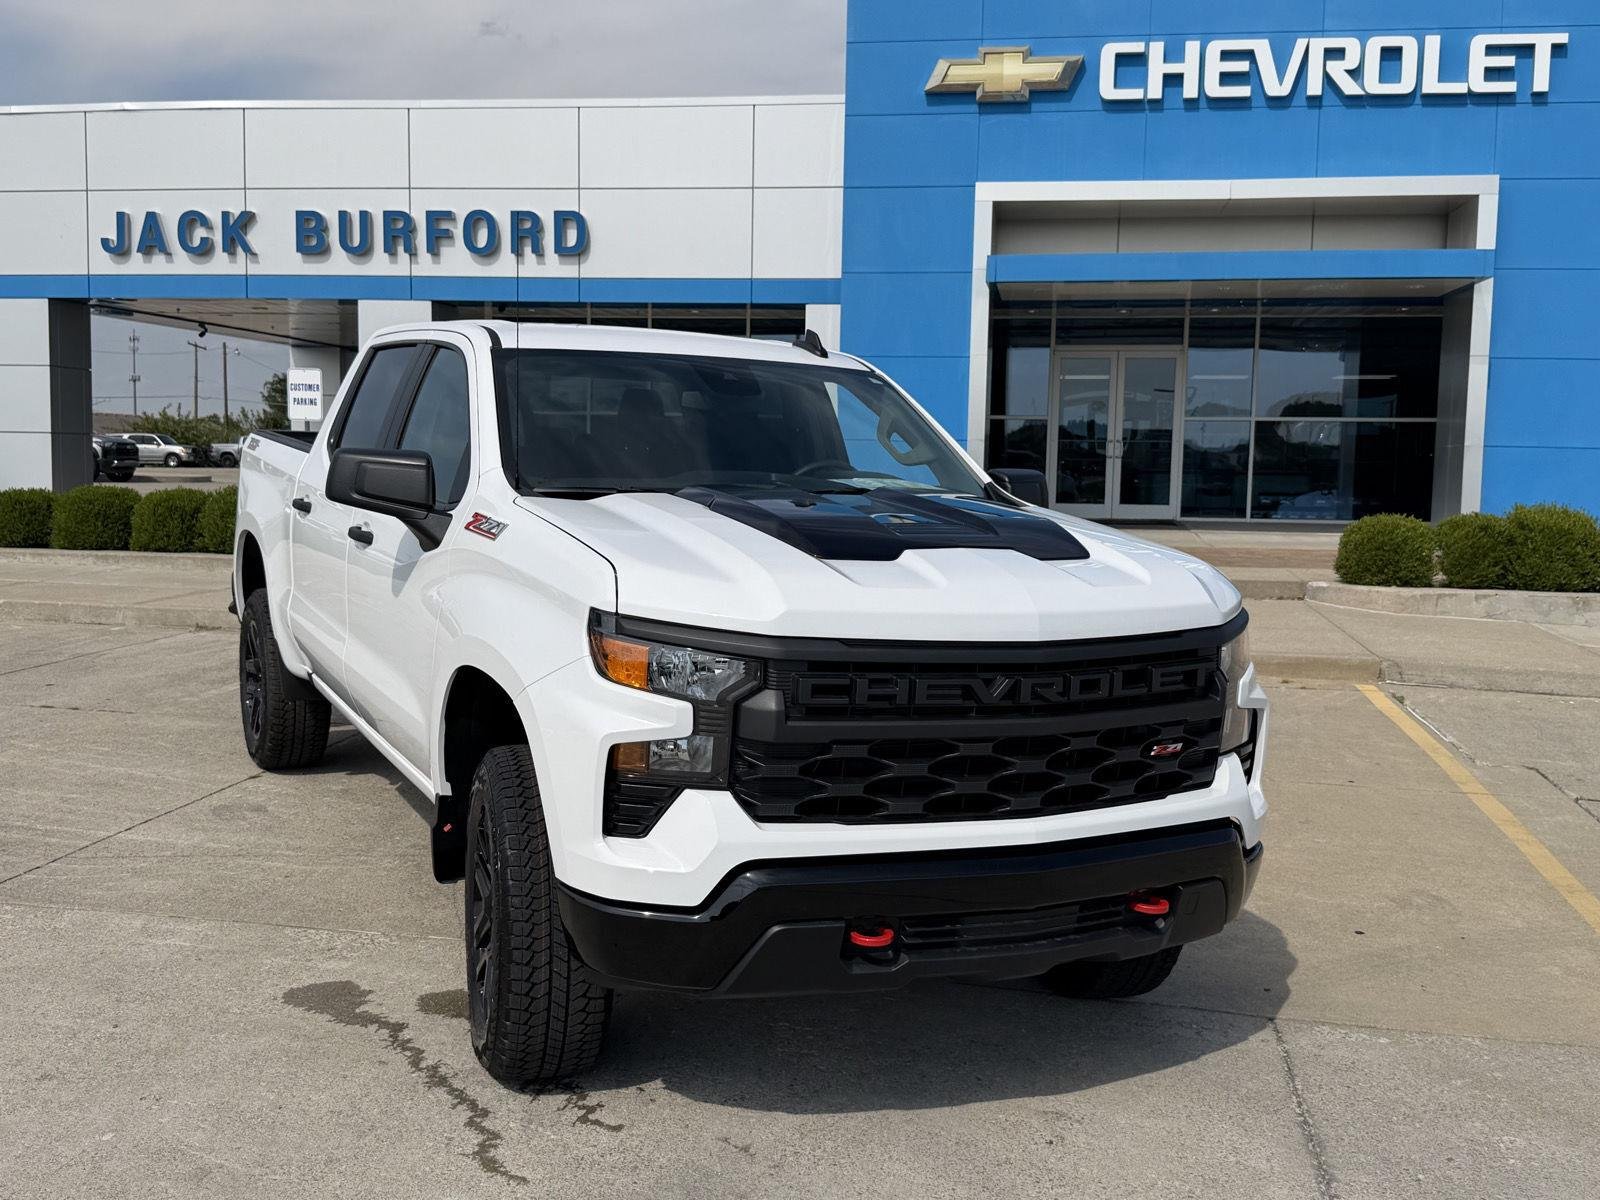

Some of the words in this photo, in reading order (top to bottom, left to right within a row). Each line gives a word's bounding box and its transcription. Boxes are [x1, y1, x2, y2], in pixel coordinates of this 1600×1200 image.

[1099, 32, 1569, 101] CHEVROLET
[100, 209, 257, 257] JACK
[294, 208, 590, 257] BURFORD
[290, 383, 320, 392] CUSTOMER
[293, 397, 317, 406] PARKING
[792, 664, 1211, 705] CHEVROLET
